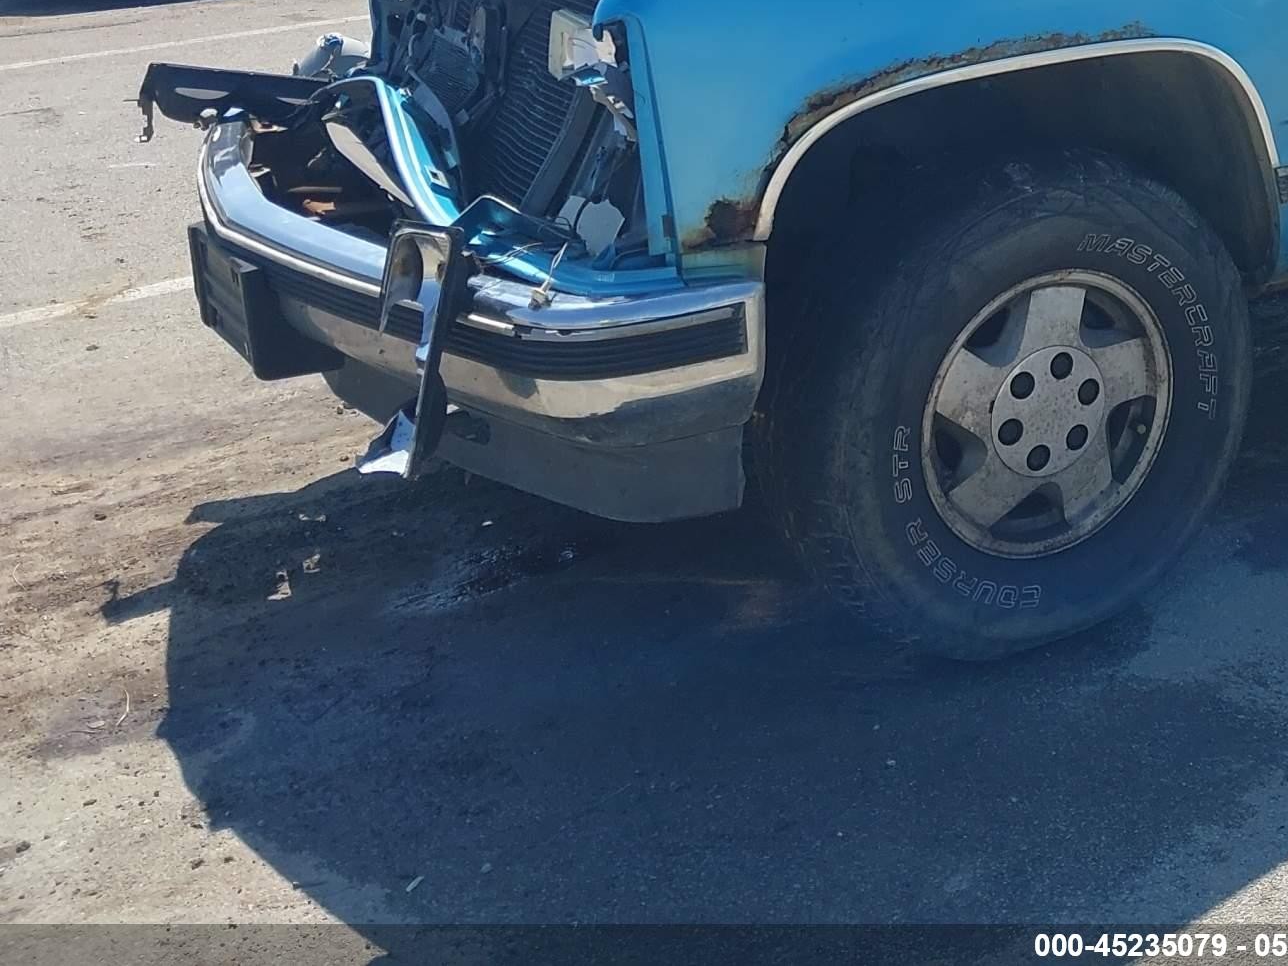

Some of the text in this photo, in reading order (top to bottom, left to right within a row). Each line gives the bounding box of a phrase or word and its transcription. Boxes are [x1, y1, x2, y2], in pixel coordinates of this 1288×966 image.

[1076, 232, 1220, 420] MASTERCRAFT
[892, 424, 1042, 610] COURSER STR
